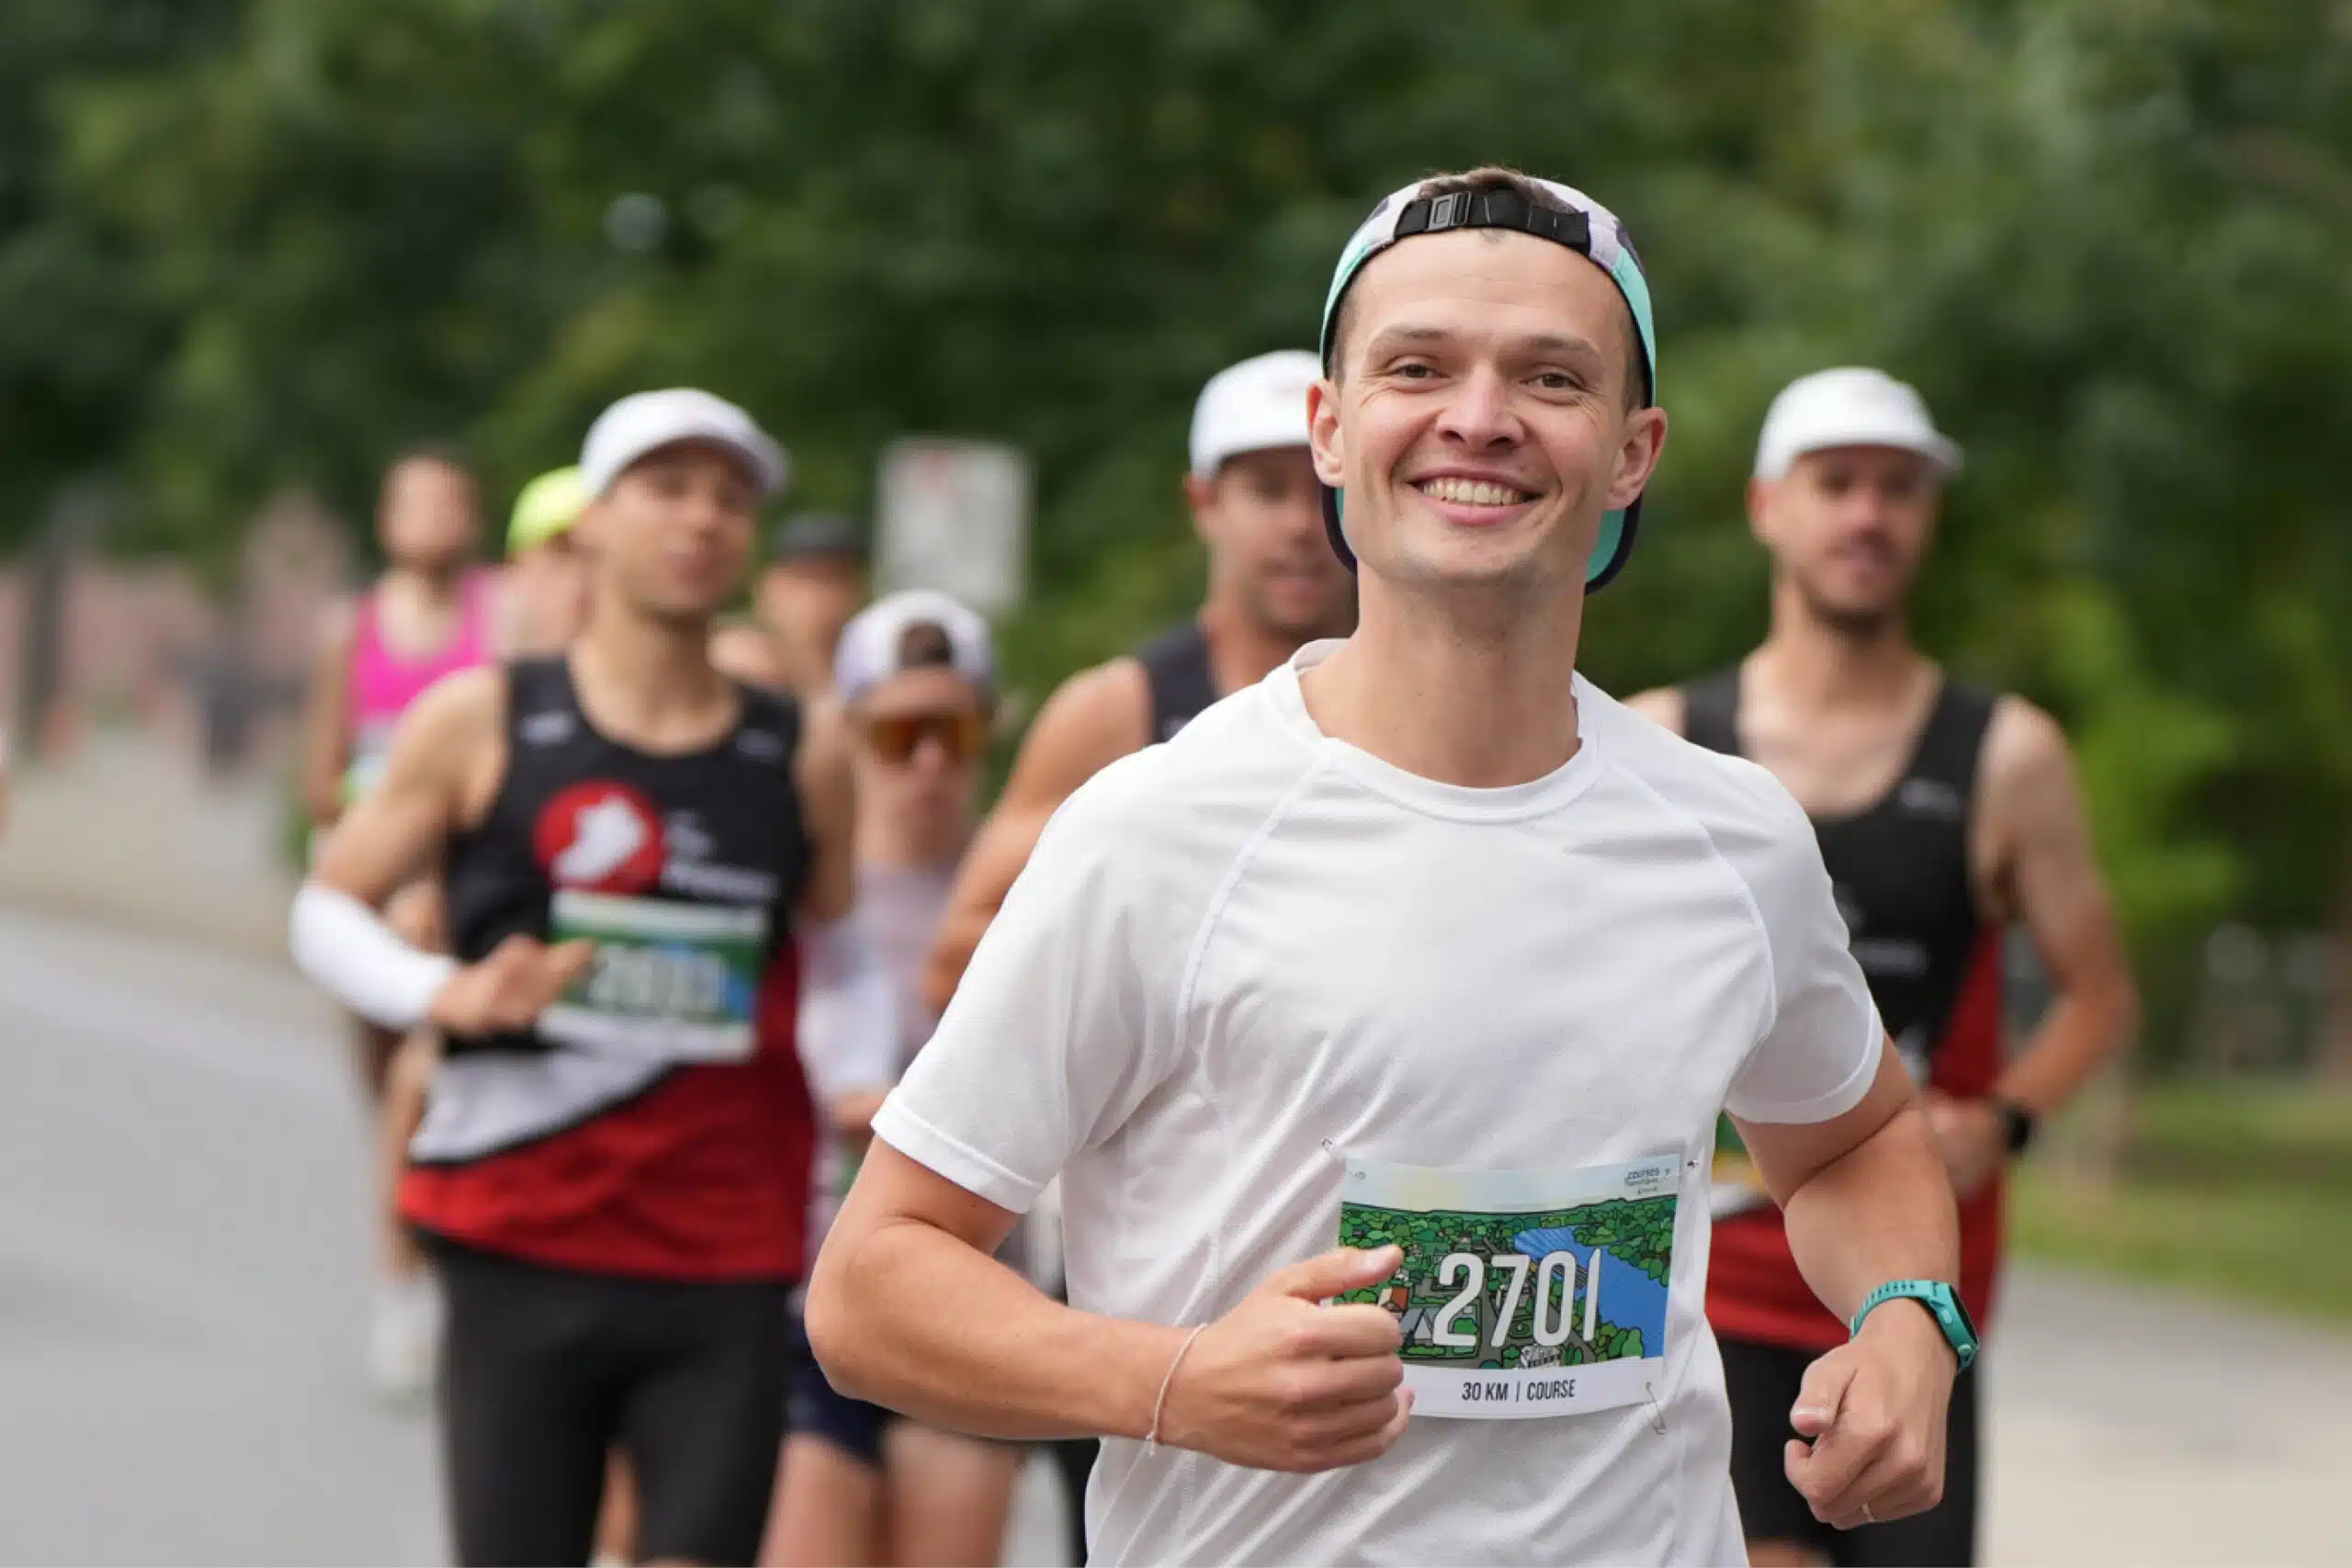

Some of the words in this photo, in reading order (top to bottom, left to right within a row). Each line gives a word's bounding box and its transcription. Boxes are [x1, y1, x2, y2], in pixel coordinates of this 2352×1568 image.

[1432, 1248, 1601, 1348] 2701
[1462, 1382, 1481, 1401] 30
[1485, 1382, 1509, 1401] KM
[1526, 1379, 1577, 1401] COURSE
